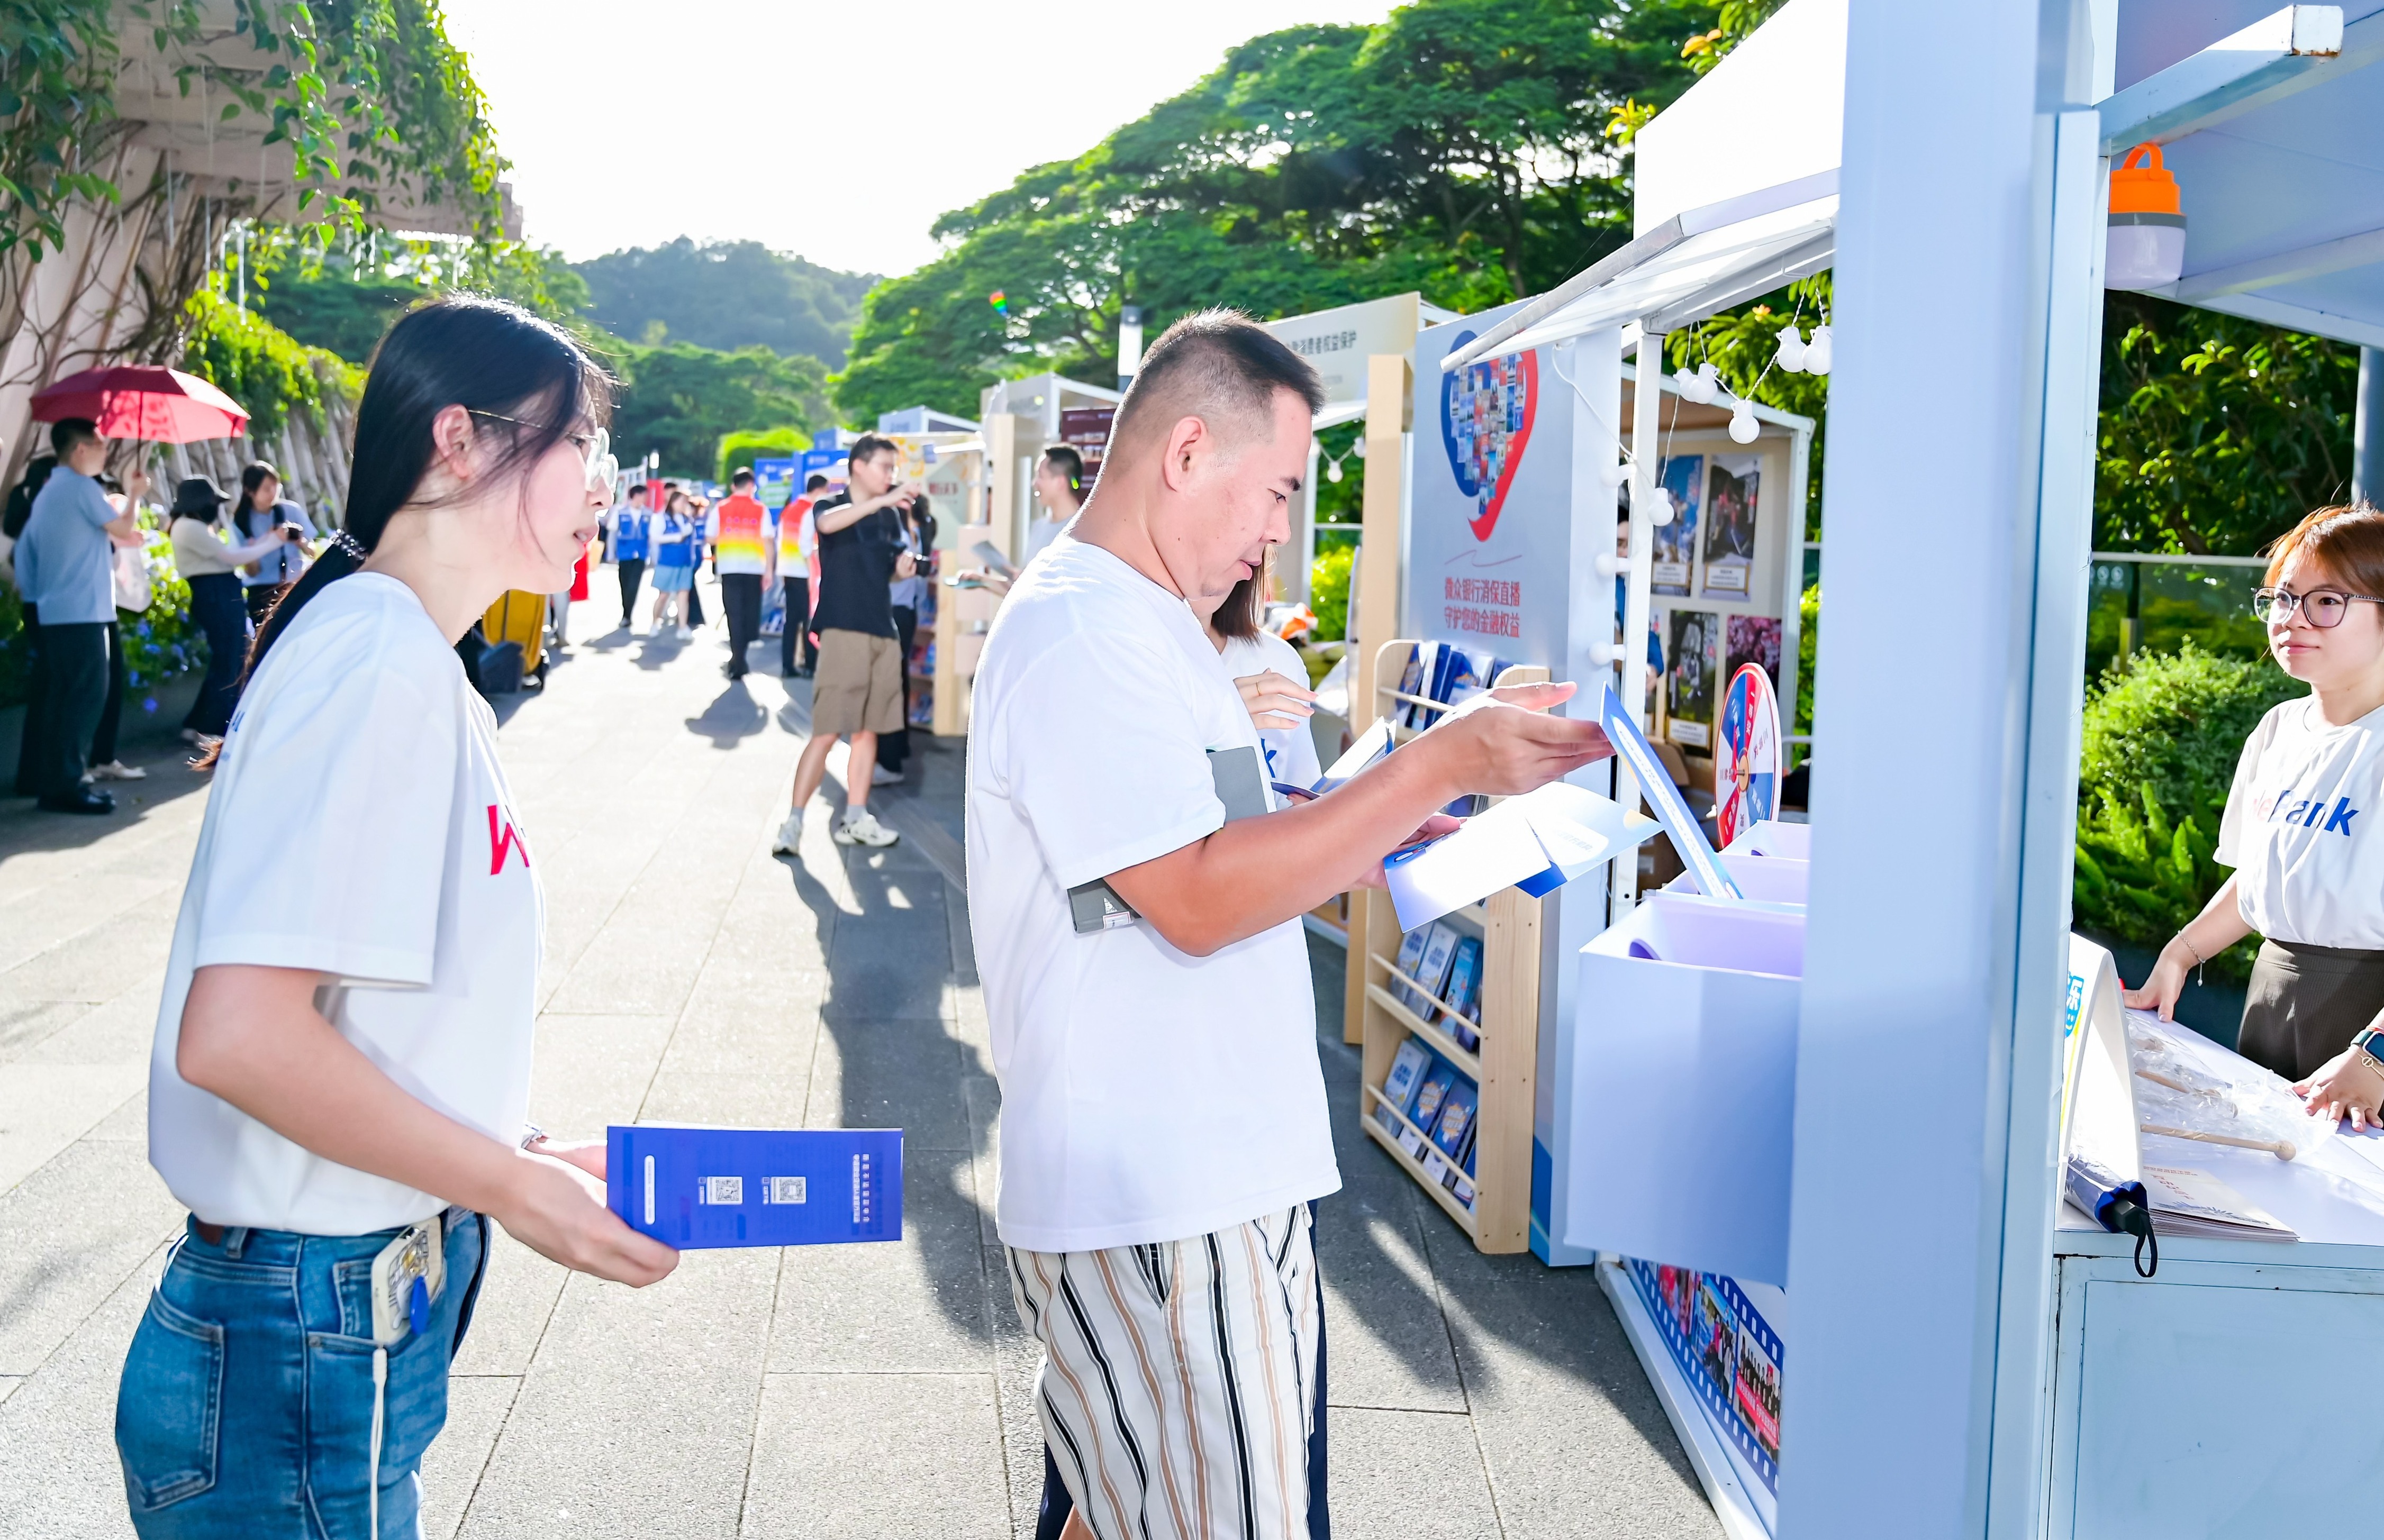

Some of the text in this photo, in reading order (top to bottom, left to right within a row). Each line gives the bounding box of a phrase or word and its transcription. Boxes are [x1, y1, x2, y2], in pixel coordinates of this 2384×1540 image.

[1445, 577, 1520, 607] 微众银行消保直播
[1444, 606, 1520, 637] 守护您的金融权益
